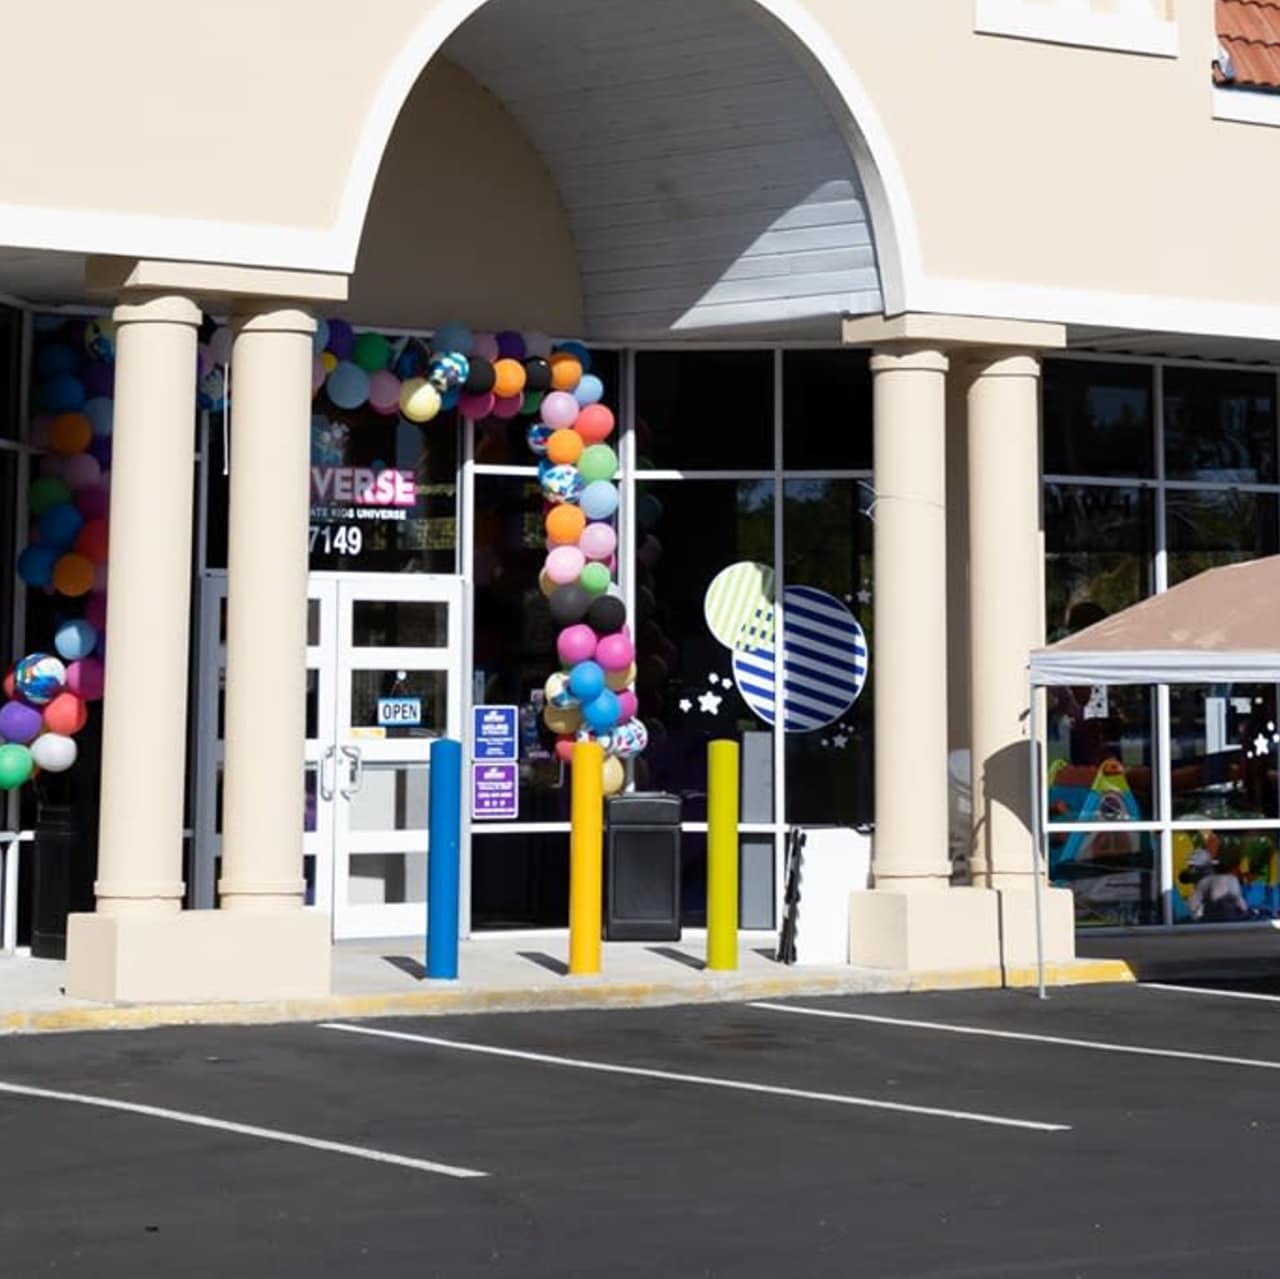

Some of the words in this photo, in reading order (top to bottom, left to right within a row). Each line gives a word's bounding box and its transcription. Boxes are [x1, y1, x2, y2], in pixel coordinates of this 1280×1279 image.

[310, 467, 416, 505] VERSE
[309, 525, 363, 555] 7149
[382, 703, 418, 720] OPEN
